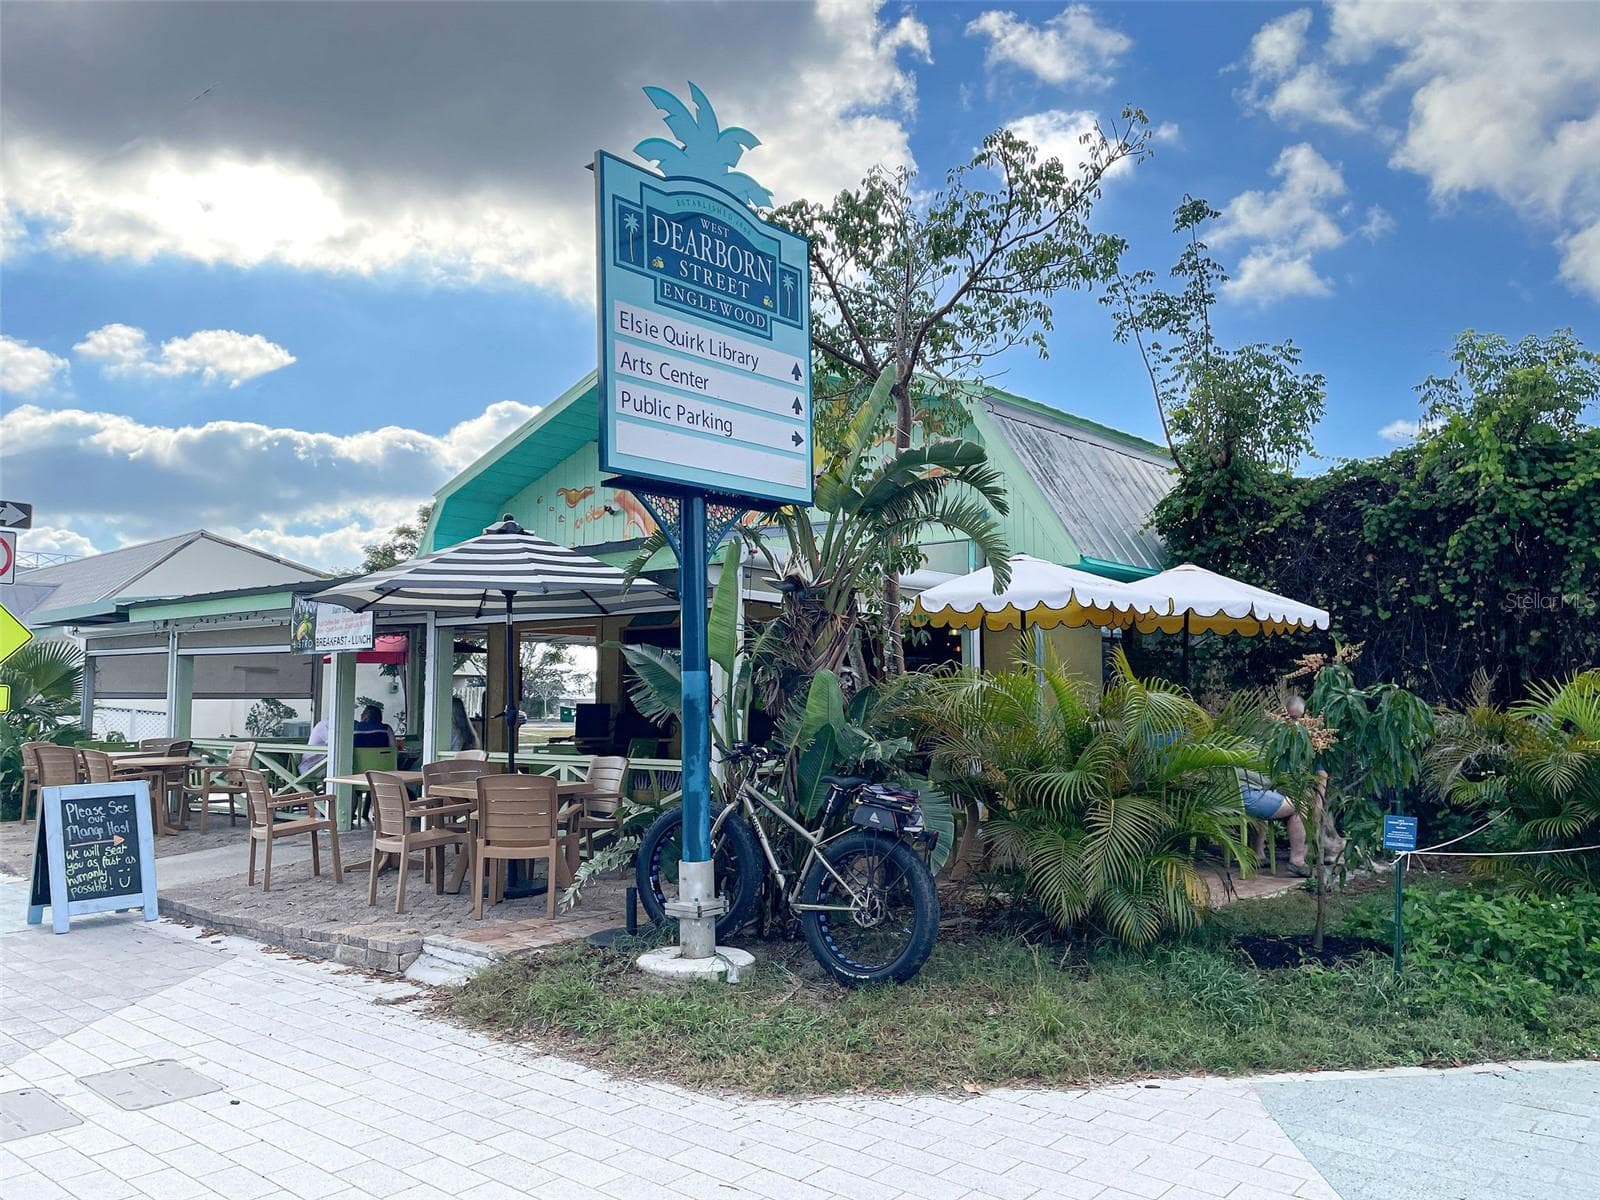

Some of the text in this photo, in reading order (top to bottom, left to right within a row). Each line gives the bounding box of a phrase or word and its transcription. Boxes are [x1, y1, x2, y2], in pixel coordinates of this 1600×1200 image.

[700, 217, 731, 239] WEST
[651, 213, 773, 287] DEARBORN
[679, 260, 750, 299] STREET
[663, 282, 766, 329] ENGLEWOOD
[620, 310, 760, 372] Elsie Quirk Library
[620, 351, 710, 391] Arts Center
[621, 390, 734, 438] Public Parking
[316, 635, 348, 648] BREAKFAST
[352, 634, 372, 646] LUNCH
[65, 800, 130, 824] Please See
[87, 815, 106, 823] our
[65, 820, 130, 841] Mango Host
[65, 845, 128, 861] We will seat
[66, 855, 137, 876] you as fast as
[66, 868, 108, 886] humanly
